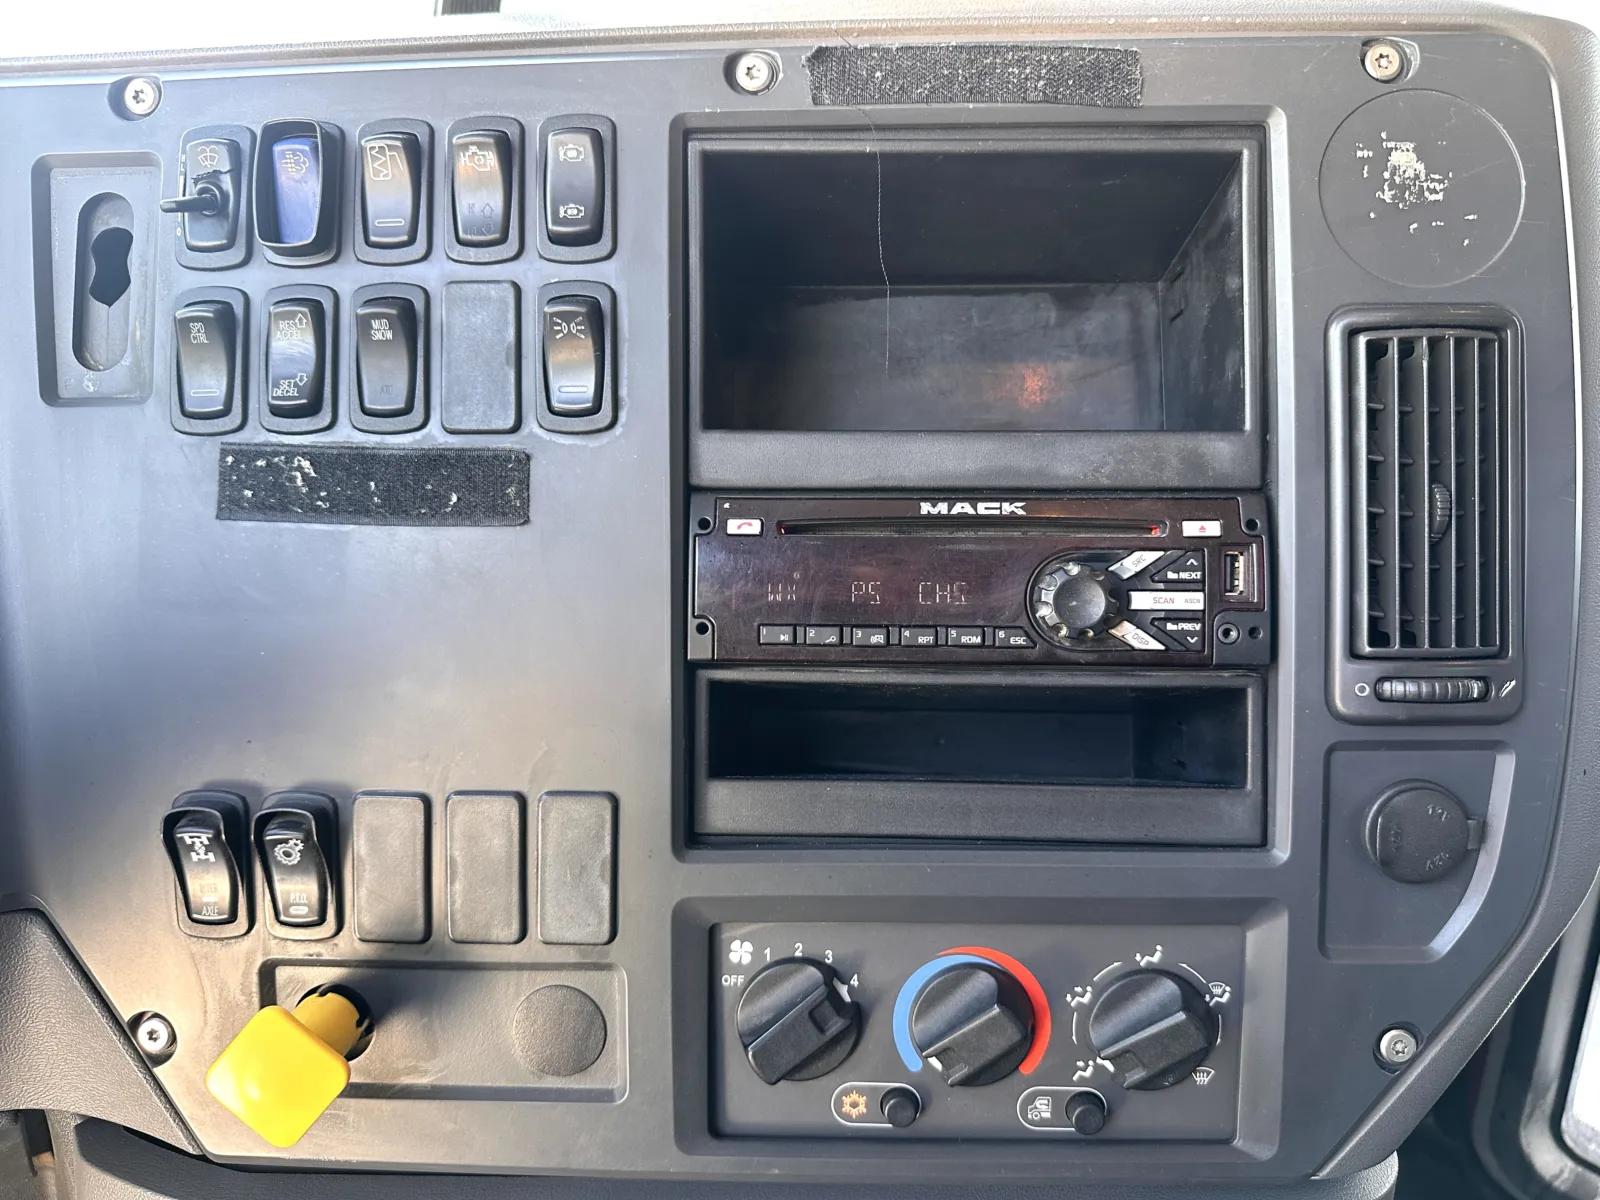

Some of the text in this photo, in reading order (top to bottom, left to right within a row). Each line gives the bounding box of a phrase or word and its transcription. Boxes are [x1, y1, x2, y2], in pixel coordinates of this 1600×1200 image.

[189, 323, 204, 333] SPD
[371, 319, 389, 329] MUD
[191, 333, 210, 344] CTRL
[371, 330, 393, 340] SNOW
[280, 379, 296, 390] SET
[273, 388, 300, 397] DECEL
[920, 501, 1027, 515] MACK
[1179, 571, 1202, 580] NEXT
[1178, 622, 1202, 631] PREV
[809, 629, 816, 637] 2
[856, 630, 862, 638] 3
[903, 630, 910, 638] 4
[950, 630, 957, 638] 5
[998, 630, 1005, 638] 6
[918, 636, 934, 644] RPT
[1010, 637, 1026, 645] ESC
[201, 905, 219, 916] AXLE
[764, 947, 771, 962] 1
[794, 943, 803, 956] 2
[824, 950, 833, 963] 3
[721, 974, 745, 987] OFF
[850, 974, 859, 987] 4
